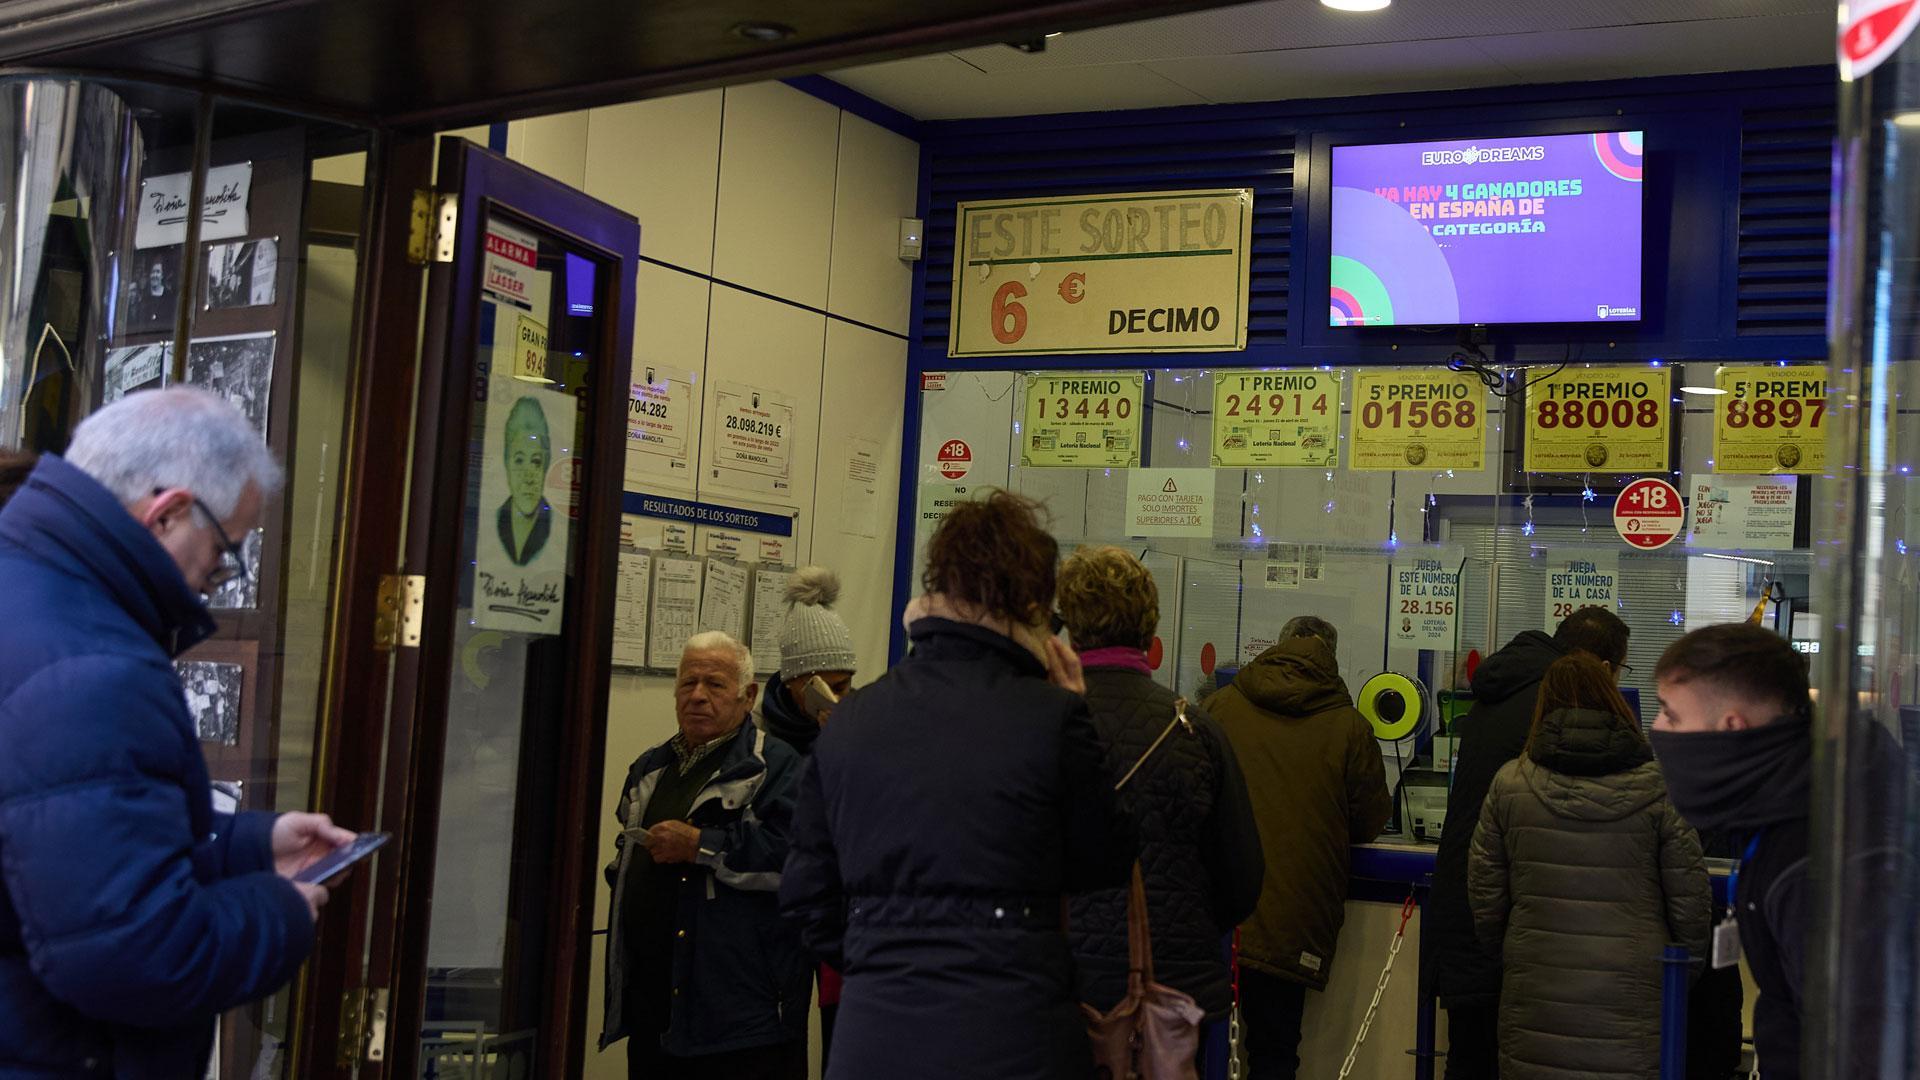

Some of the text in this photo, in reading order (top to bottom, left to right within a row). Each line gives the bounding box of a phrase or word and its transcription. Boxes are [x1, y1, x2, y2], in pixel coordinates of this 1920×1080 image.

[1422, 145, 1544, 165] EURO DREAMS
[1404, 185, 1443, 203] HAY
[1446, 184, 1459, 200] 4
[1462, 179, 1583, 200] GANADORES
[1409, 195, 1545, 220] EN ESPAÑA DE
[970, 202, 1227, 258] ESTE SORTEO
[1432, 218, 1546, 236] CATEGORÍA
[487, 236, 529, 263] ALARMA
[990, 272, 1086, 344] 6 €
[1108, 306, 1220, 335] DECIMO
[522, 326, 540, 347] GRAN
[526, 349, 546, 376] 89.4
[1061, 380, 1121, 395] PREMIO
[1253, 376, 1317, 391] PREMIO
[1388, 383, 1468, 400] PREMIO
[1563, 381, 1648, 399] PREMIO
[1756, 381, 1827, 398] PREMI
[629, 398, 667, 418] 704.282
[1038, 397, 1131, 419] 13440
[1226, 393, 1328, 416] 24914
[1726, 399, 1827, 428] 8897
[1362, 400, 1476, 428] 01568
[1537, 399, 1659, 429] 88008
[726, 415, 782, 438] 28.098.219 €
[736, 452, 748, 460] DOÑA
[944, 443, 965, 457] +18
[1137, 494, 1157, 502] PAGO
[1158, 494, 1173, 502] CON
[1629, 486, 1667, 509] +18
[1698, 485, 1711, 493] CON
[643, 500, 759, 527] RESULTADOS DE LOS SORTEOS
[1143, 504, 1198, 513] SOLO IMPORTES
[1136, 515, 1202, 525] SUPERIORES A 10€
[1416, 560, 1442, 571] JUEGA
[1568, 561, 1597, 574] JUEGA
[1400, 572, 1419, 583] ESTE
[1552, 574, 1572, 585] ESTE
[1400, 585, 1455, 597] DE LA CASA
[1553, 587, 1610, 600] DE LA CASA
[1401, 600, 1453, 615] 28.156
